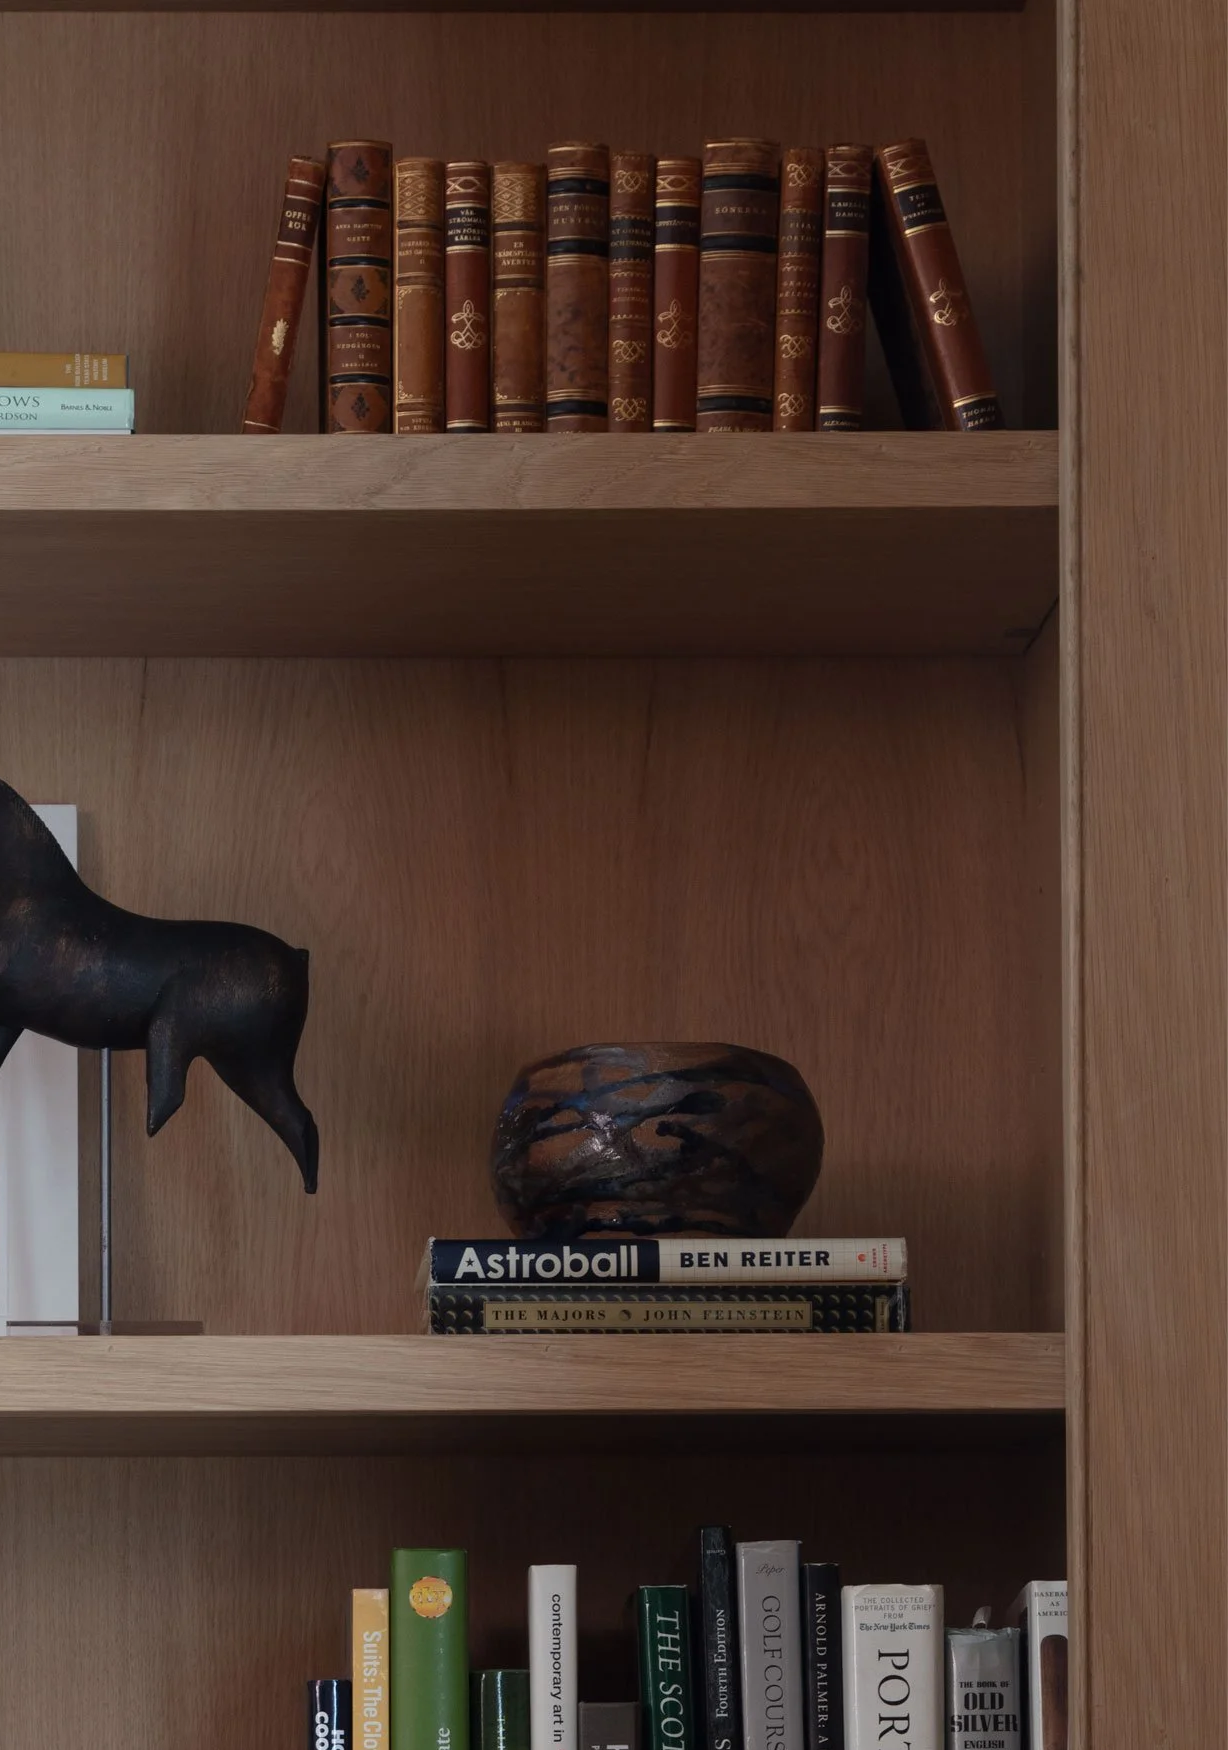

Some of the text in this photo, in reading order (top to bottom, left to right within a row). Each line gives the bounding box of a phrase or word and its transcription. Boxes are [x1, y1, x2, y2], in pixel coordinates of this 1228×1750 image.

[92, 404, 113, 412] NOBLE
[454, 1245, 639, 1279] Astroball
[680, 1250, 831, 1268] BEN REITER
[492, 1309, 805, 1322] THE MAJORS JOHN FEINSTEIN
[762, 1595, 783, 1660] GOLF
[815, 1592, 827, 1657] ARNOLD
[363, 1631, 382, 1683] Suits:
[656, 1610, 681, 1672] THE
[550, 1593, 564, 1743] contemporary art in
[713, 1609, 729, 1718] FOURTH EDITION
[363, 1687, 382, 1718] The
[817, 1663, 829, 1728] PALMER:
[963, 1692, 1005, 1710] OLD
[818, 1735, 828, 1744] A
[950, 1714, 1019, 1733] SILVER
[964, 1740, 1005, 1749] ENGLISH
